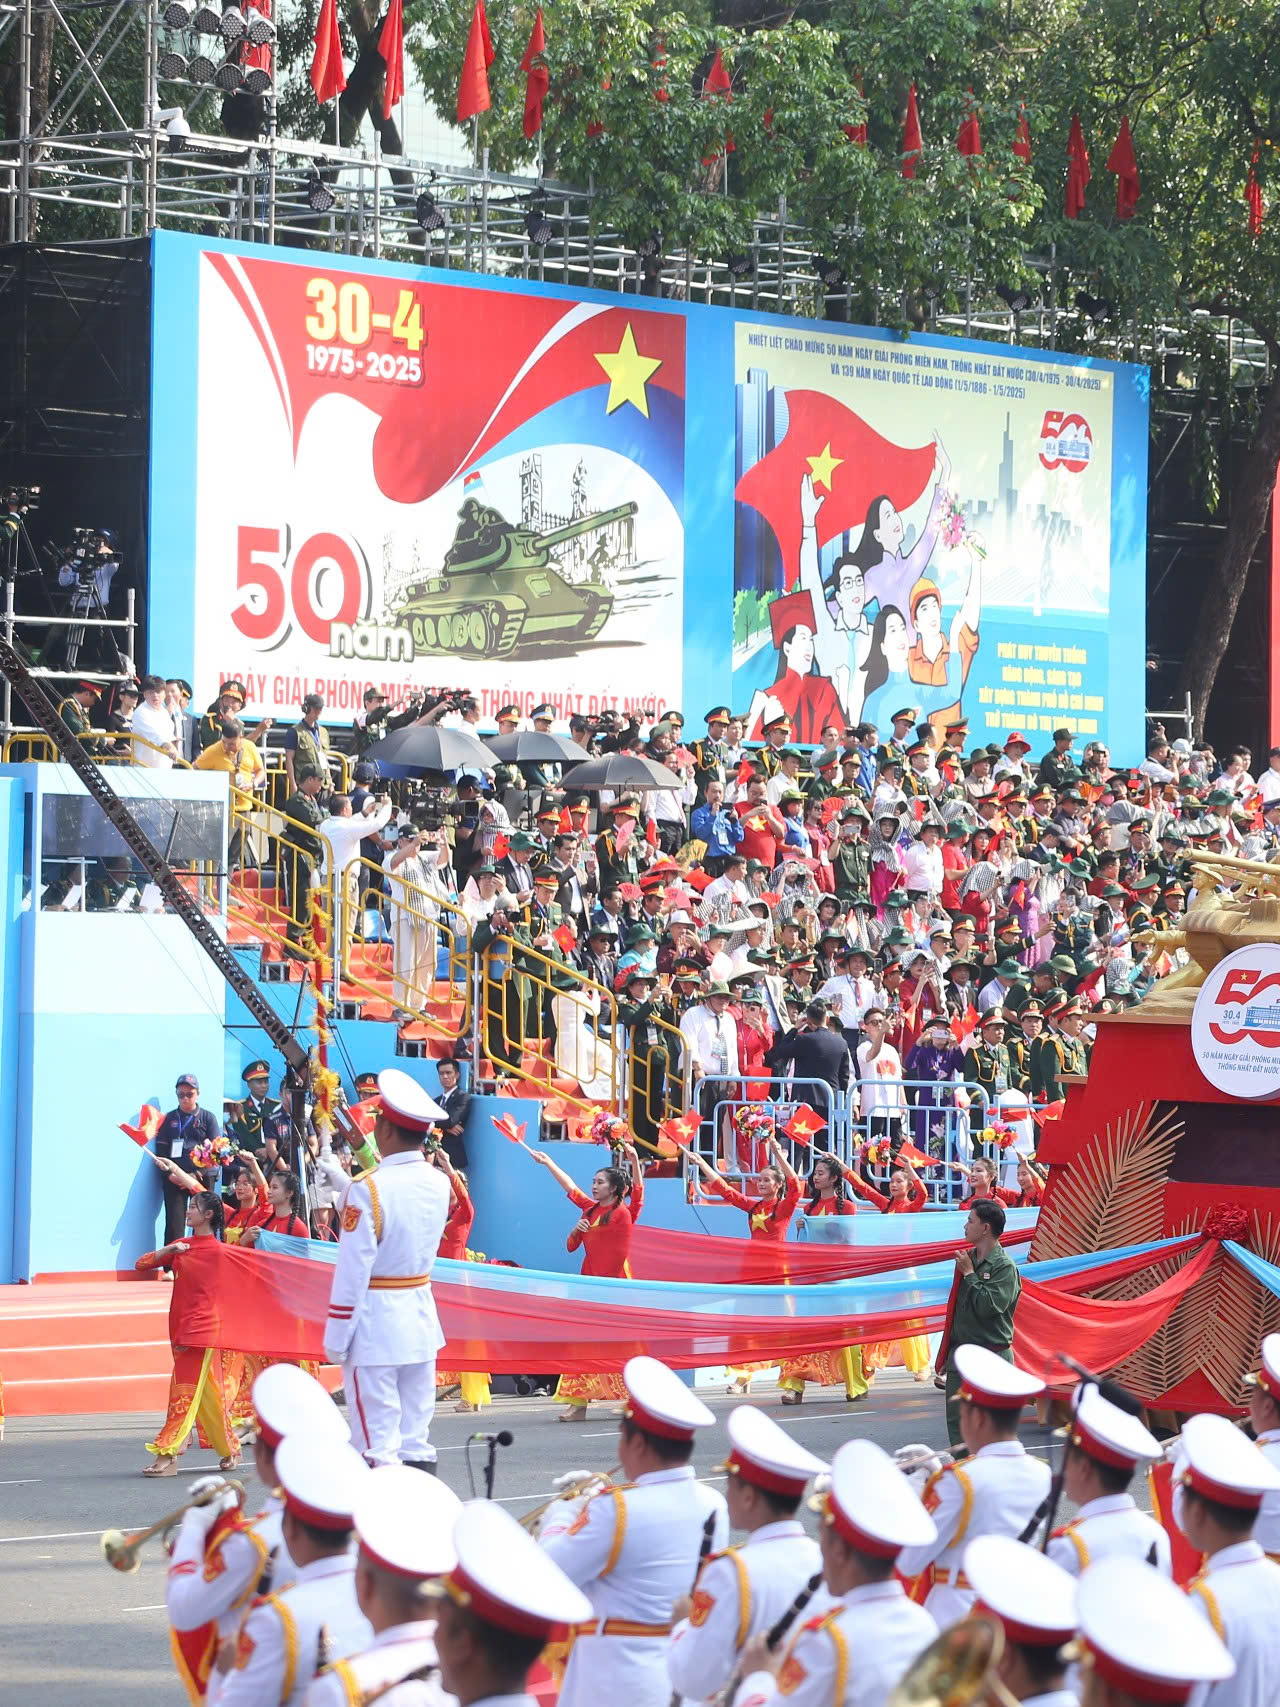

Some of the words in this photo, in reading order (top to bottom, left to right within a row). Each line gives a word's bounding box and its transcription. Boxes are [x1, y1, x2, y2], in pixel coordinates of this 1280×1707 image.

[306, 278, 425, 351] 30-4
[827, 344, 836, 356] 50
[831, 361, 840, 375] VÀ
[842, 365, 854, 378] 139
[921, 375, 933, 387] LAO
[230, 525, 362, 645] 50
[330, 618, 414, 662] năm
[315, 673, 375, 709] PHÓN
[1223, 1010, 1241, 1020] 30.4
[1202, 1051, 1210, 1059] 50
[1211, 1051, 1224, 1060] NĂM
[1224, 1052, 1239, 1061] NGÀY
[1239, 1052, 1251, 1061] GIẢI
